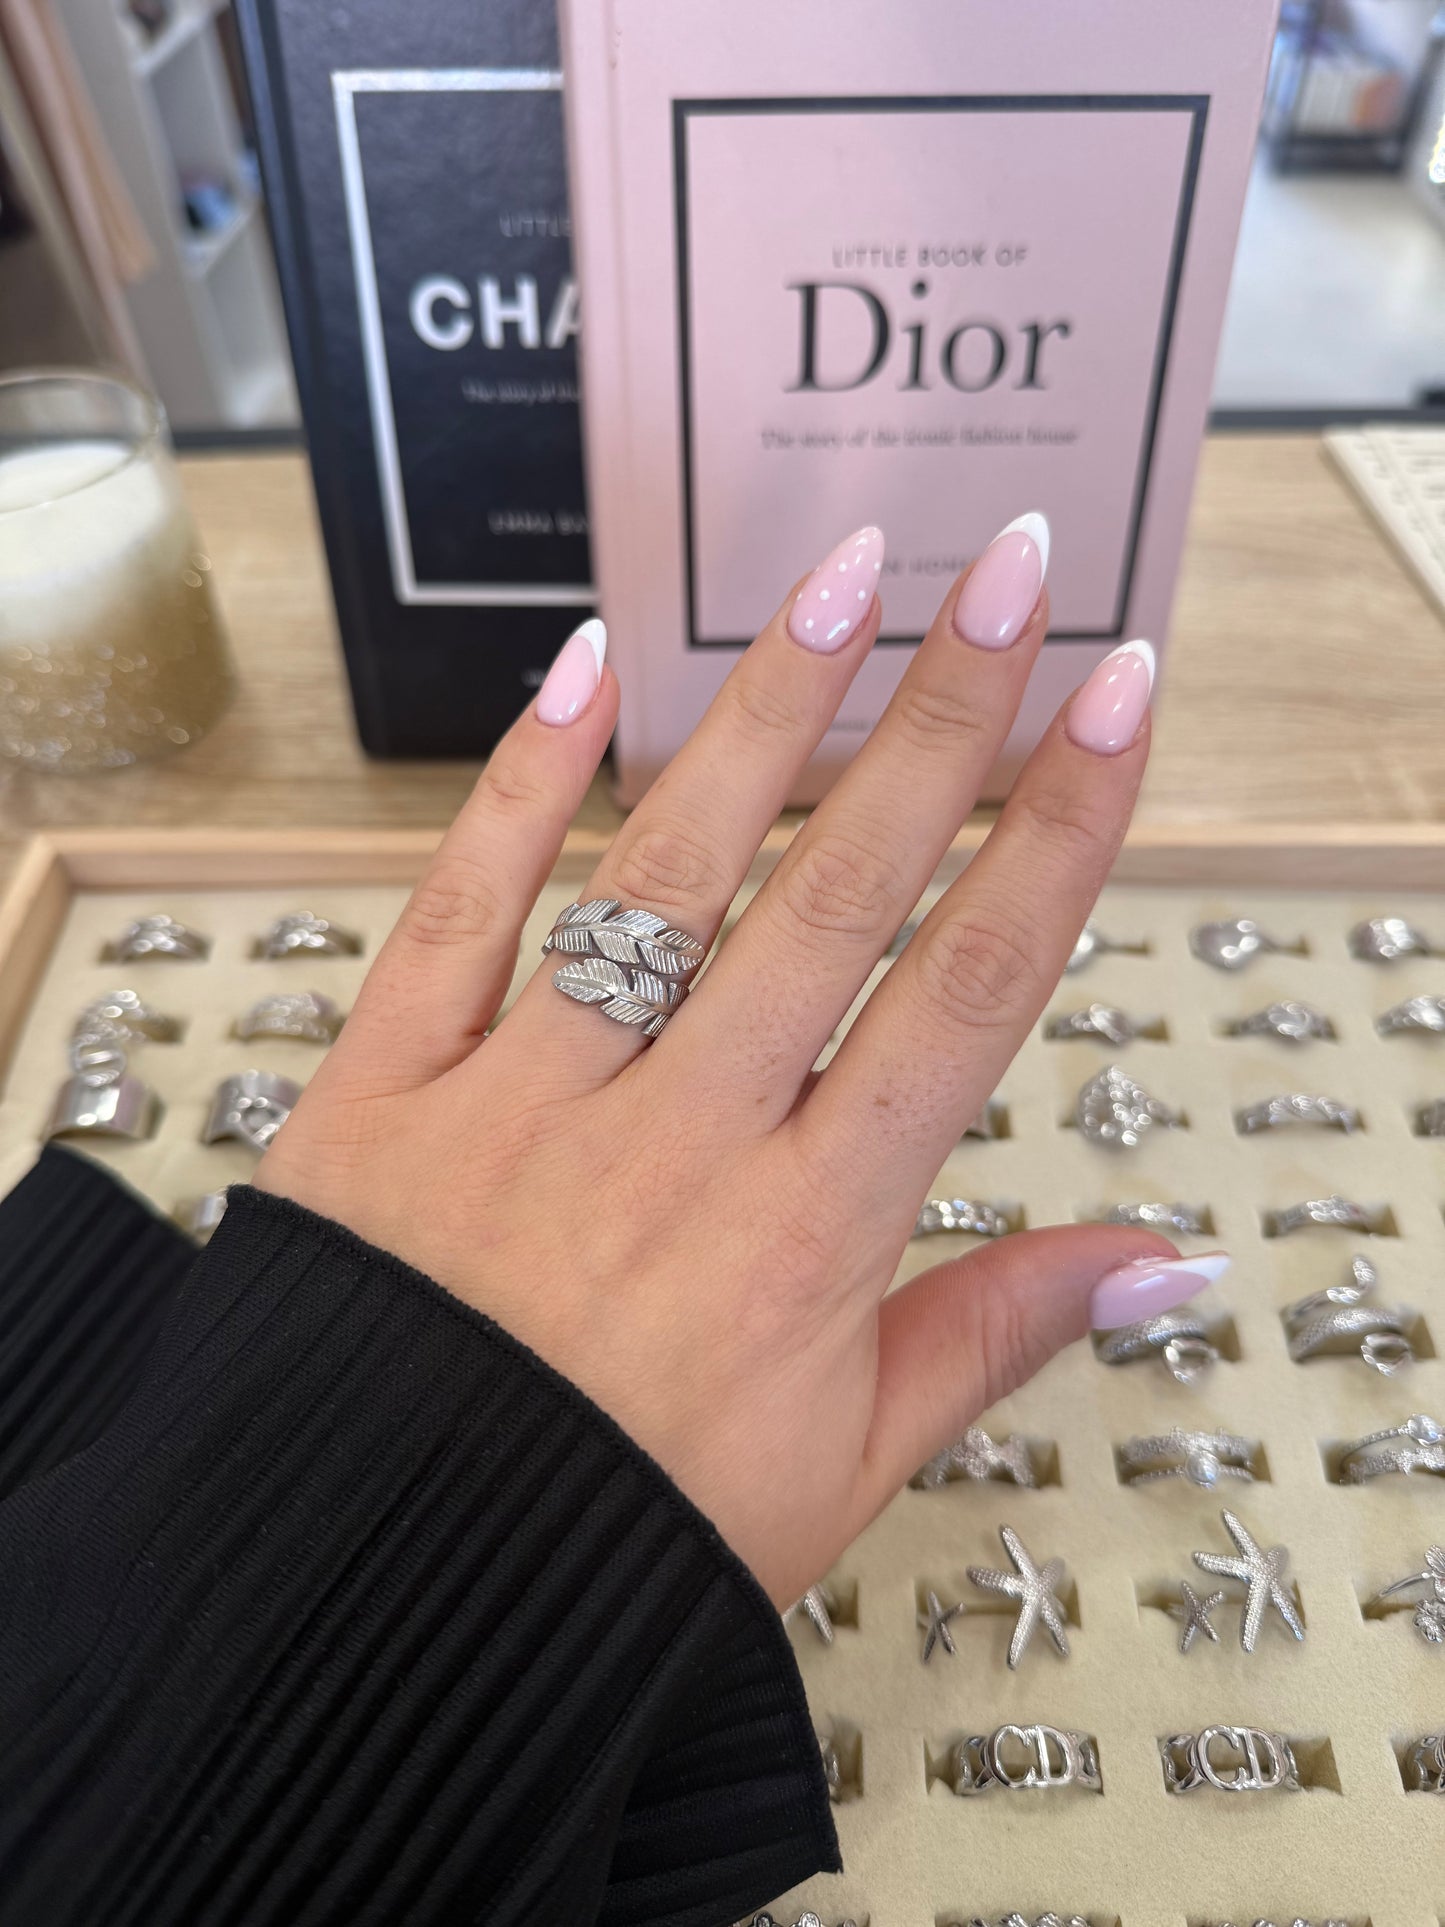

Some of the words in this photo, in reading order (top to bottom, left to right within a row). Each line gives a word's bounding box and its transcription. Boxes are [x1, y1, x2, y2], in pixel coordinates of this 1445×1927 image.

[831, 245, 907, 269] LITTLE
[916, 244, 986, 268] BOOK
[995, 243, 1029, 267] OF
[783, 277, 1072, 394] Dior
